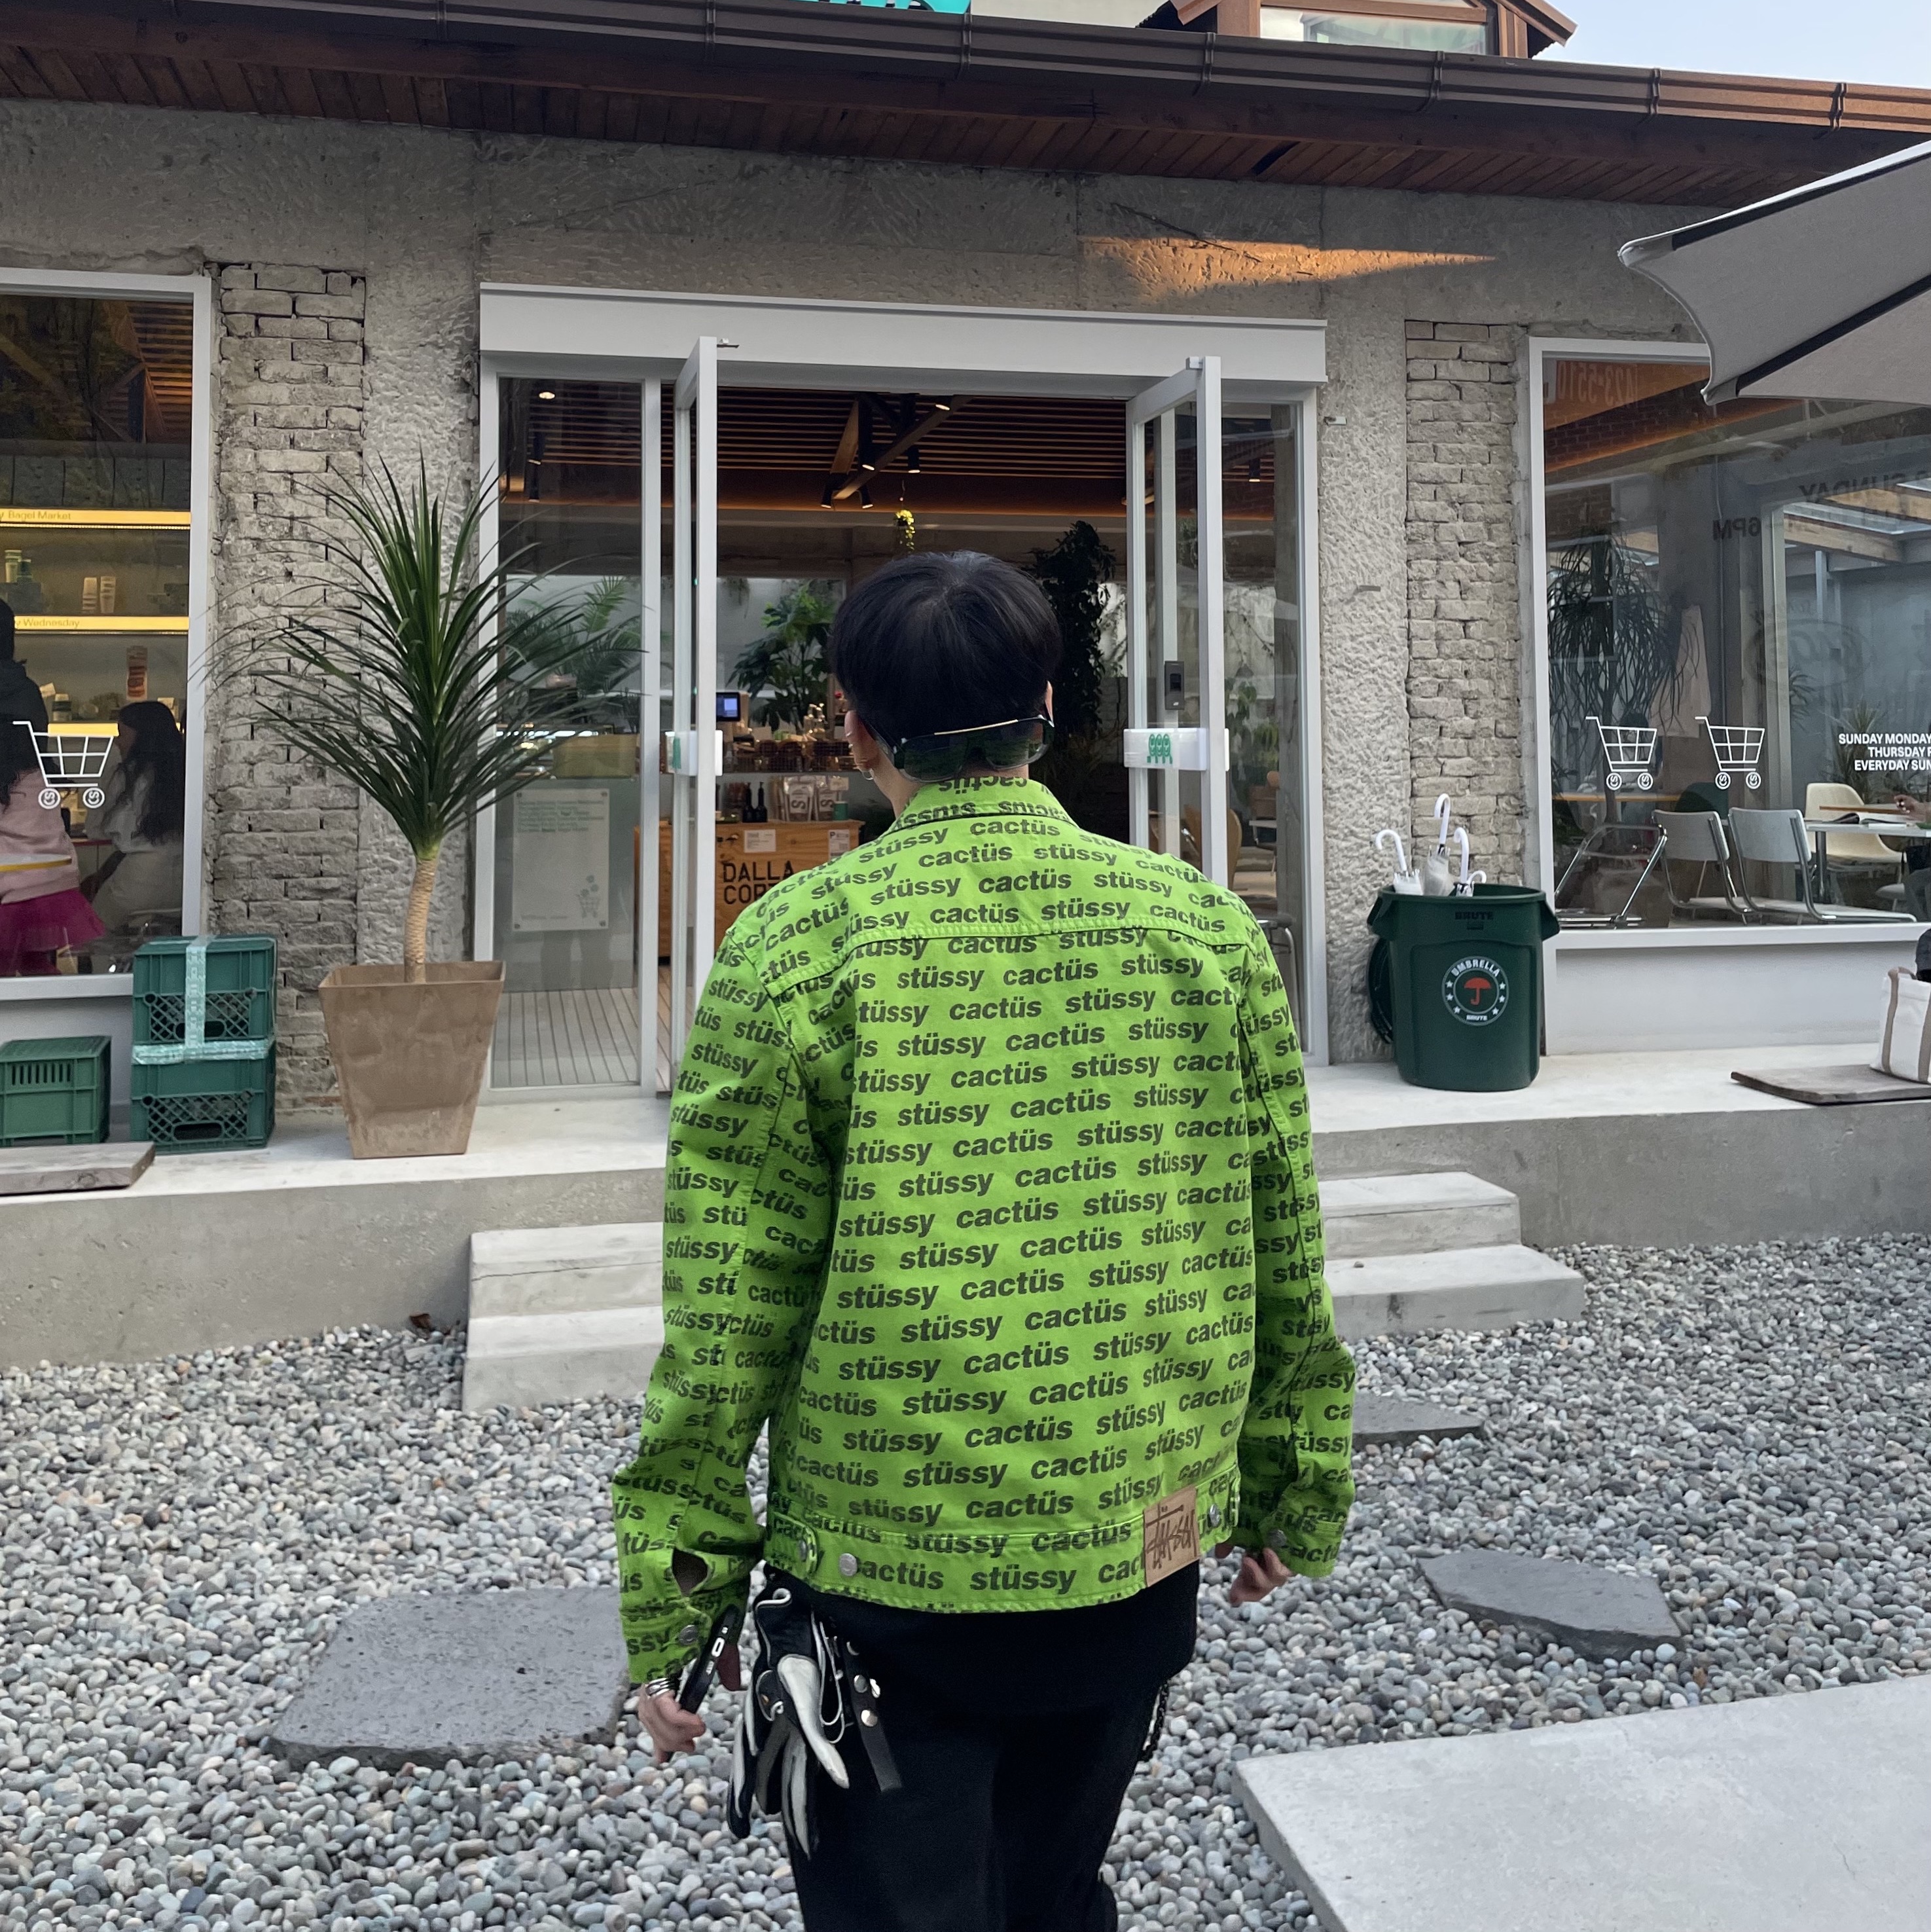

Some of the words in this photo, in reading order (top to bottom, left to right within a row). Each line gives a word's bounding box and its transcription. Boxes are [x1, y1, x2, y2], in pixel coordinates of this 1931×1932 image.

[9, 511, 35, 522] Bagel
[38, 511, 71, 519] Market
[24, 618, 80, 628] Wednesday
[1838, 733, 1883, 744] SUNDAY
[1885, 733, 1931, 744] MONDAY
[1868, 746, 1926, 757] THURSDAY
[1854, 759, 1909, 771] EVERYDAY
[859, 828, 948, 863] stüssy
[970, 819, 1060, 835] cactüs
[722, 861, 795, 883] DALLA
[811, 862, 897, 900] stüssy
[918, 843, 1013, 867] cactüs
[1034, 843, 1117, 866] stüssy
[871, 877, 961, 905] stüssy
[978, 869, 1072, 894] cactüs
[1094, 871, 1172, 897] stüssy
[724, 884, 776, 905] COR
[929, 903, 1019, 924] cactüs
[1041, 898, 1130, 920] stüssy
[1149, 905, 1225, 933] cactüs
[897, 966, 984, 991] stüssy
[1003, 958, 1099, 985] cactüs
[1121, 953, 1204, 979] stüssy
[1451, 959, 1500, 977] UMBRELLA
[708, 978, 768, 1013] stüssy
[857, 1000, 929, 1027] tüssy
[949, 996, 1042, 1021] cactüs
[1065, 988, 1156, 1013] stüssy
[897, 1032, 986, 1058] stüssy
[1005, 1023, 1105, 1051] cactüs
[1128, 1017, 1210, 1044] stüssy
[691, 1042, 759, 1079] stüssy
[950, 1061, 1047, 1089] cactüs
[1071, 1053, 1161, 1079] stüssy
[671, 1103, 749, 1139] stüssy
[897, 1101, 990, 1127] stüssy
[1010, 1089, 1111, 1119] cactüs
[1133, 1084, 1209, 1110] stüssy
[952, 1129, 1053, 1158] cactüs
[1077, 1120, 1164, 1147] stüssy
[668, 1167, 740, 1199] stüssy
[898, 1171, 994, 1197] stüssy
[1015, 1156, 1117, 1188] cactüs
[1137, 1150, 1208, 1176] stüssy
[839, 1211, 935, 1238] stüssy
[956, 1197, 1059, 1229] cactüs
[1083, 1189, 1168, 1216] stüssy
[666, 1235, 740, 1265] stüssy
[899, 1242, 999, 1270] stüssy
[1020, 1227, 1123, 1258] cactüs
[1141, 1219, 1206, 1246] stüssy
[837, 1283, 939, 1311] stüssy
[960, 1269, 1064, 1300] cactüs
[1088, 1260, 1169, 1288] stüssy
[1182, 1246, 1253, 1275] cactüs
[900, 1315, 1003, 1343] stüssy
[1024, 1299, 1127, 1331] cactüs
[1144, 1288, 1208, 1317] stüssy
[838, 1355, 942, 1383] stüssy
[964, 1341, 1069, 1374] cactüs
[1093, 1332, 1172, 1361] stüssy
[1185, 1311, 1254, 1345] cactüs
[799, 1385, 877, 1417] cactüs
[901, 1387, 1008, 1416] stüssy
[1029, 1372, 1128, 1406] cactüs
[1143, 1357, 1214, 1388] stüssy
[842, 1429, 943, 1456] stüssy
[964, 1415, 1073, 1448] cactüs
[1096, 1401, 1166, 1435] stüssy
[1179, 1379, 1247, 1412] cactüs
[796, 1455, 879, 1487] cactüs
[903, 1461, 1009, 1489] stüssy
[1030, 1446, 1127, 1480] cactüs
[1144, 1425, 1205, 1461] stüssy
[848, 1499, 943, 1527] stüssy
[966, 1490, 1074, 1519] cactüs
[1098, 1475, 1163, 1510] stüssy
[904, 1533, 1009, 1559] stüssy
[1032, 1520, 1132, 1552] cactüs
[969, 1563, 1077, 1595] stüssy
